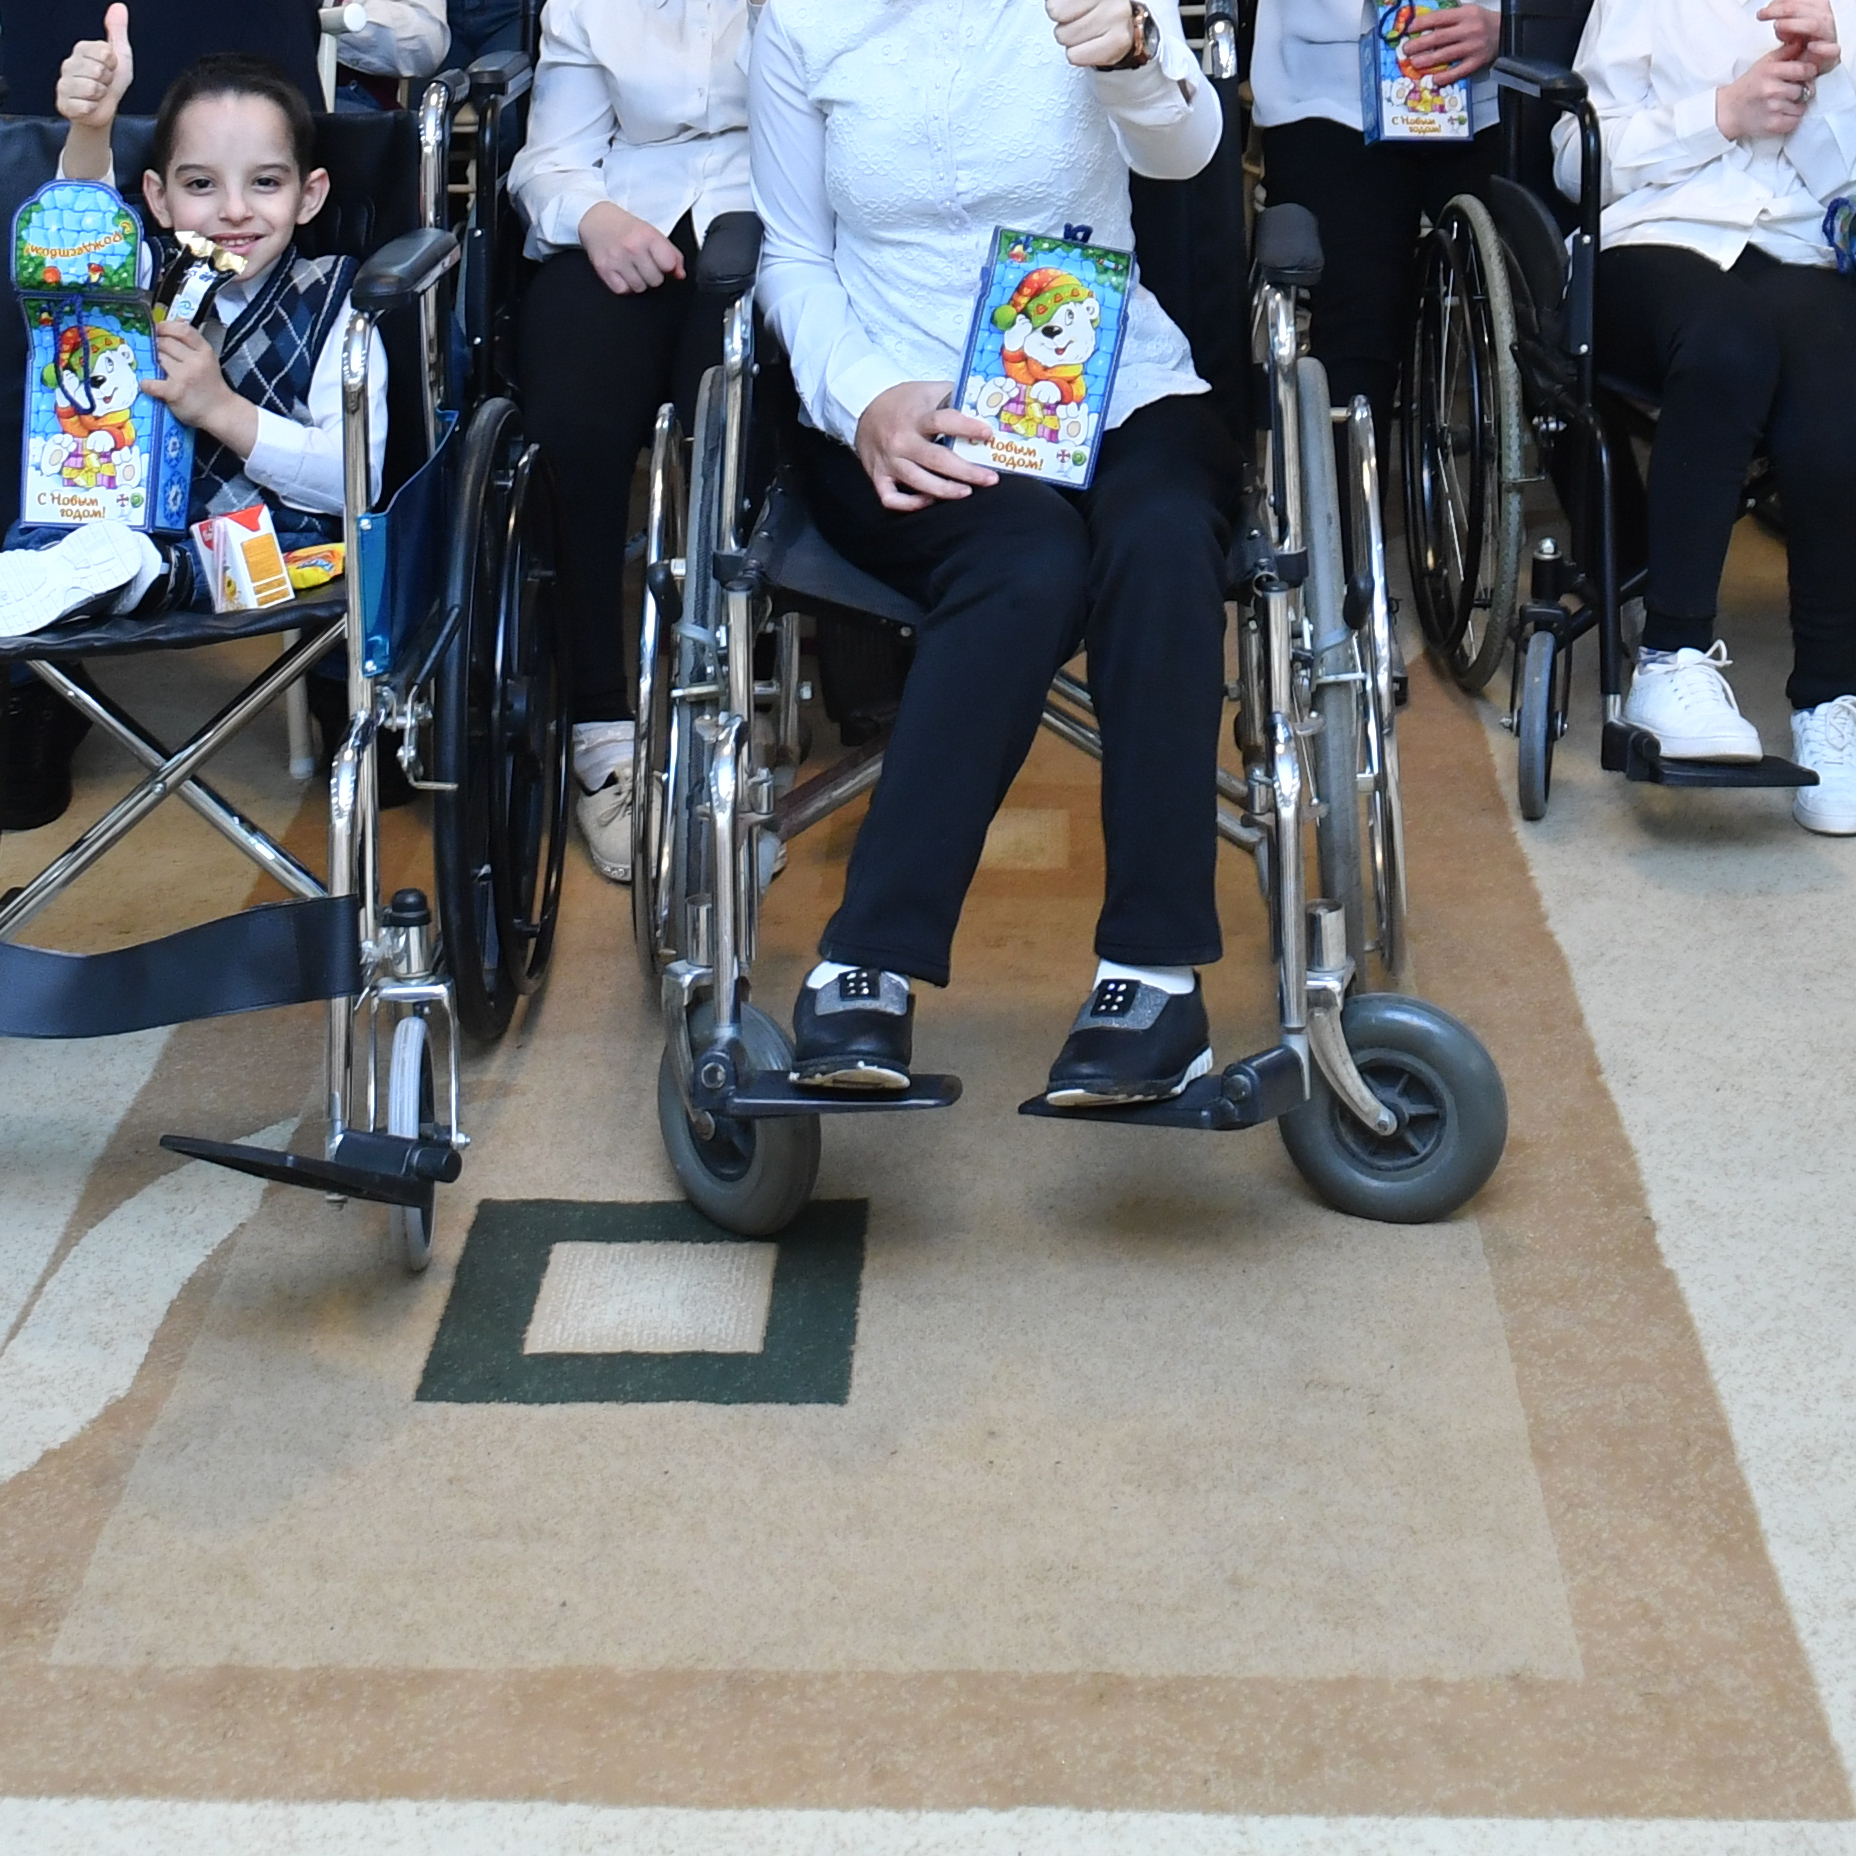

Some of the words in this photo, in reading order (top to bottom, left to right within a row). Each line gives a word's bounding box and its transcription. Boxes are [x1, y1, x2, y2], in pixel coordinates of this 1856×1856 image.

[985, 436, 1037, 456] Новым
[991, 452, 1044, 471] годом!
[50, 492, 99, 507] Новым
[60, 506, 107, 521] годом!
